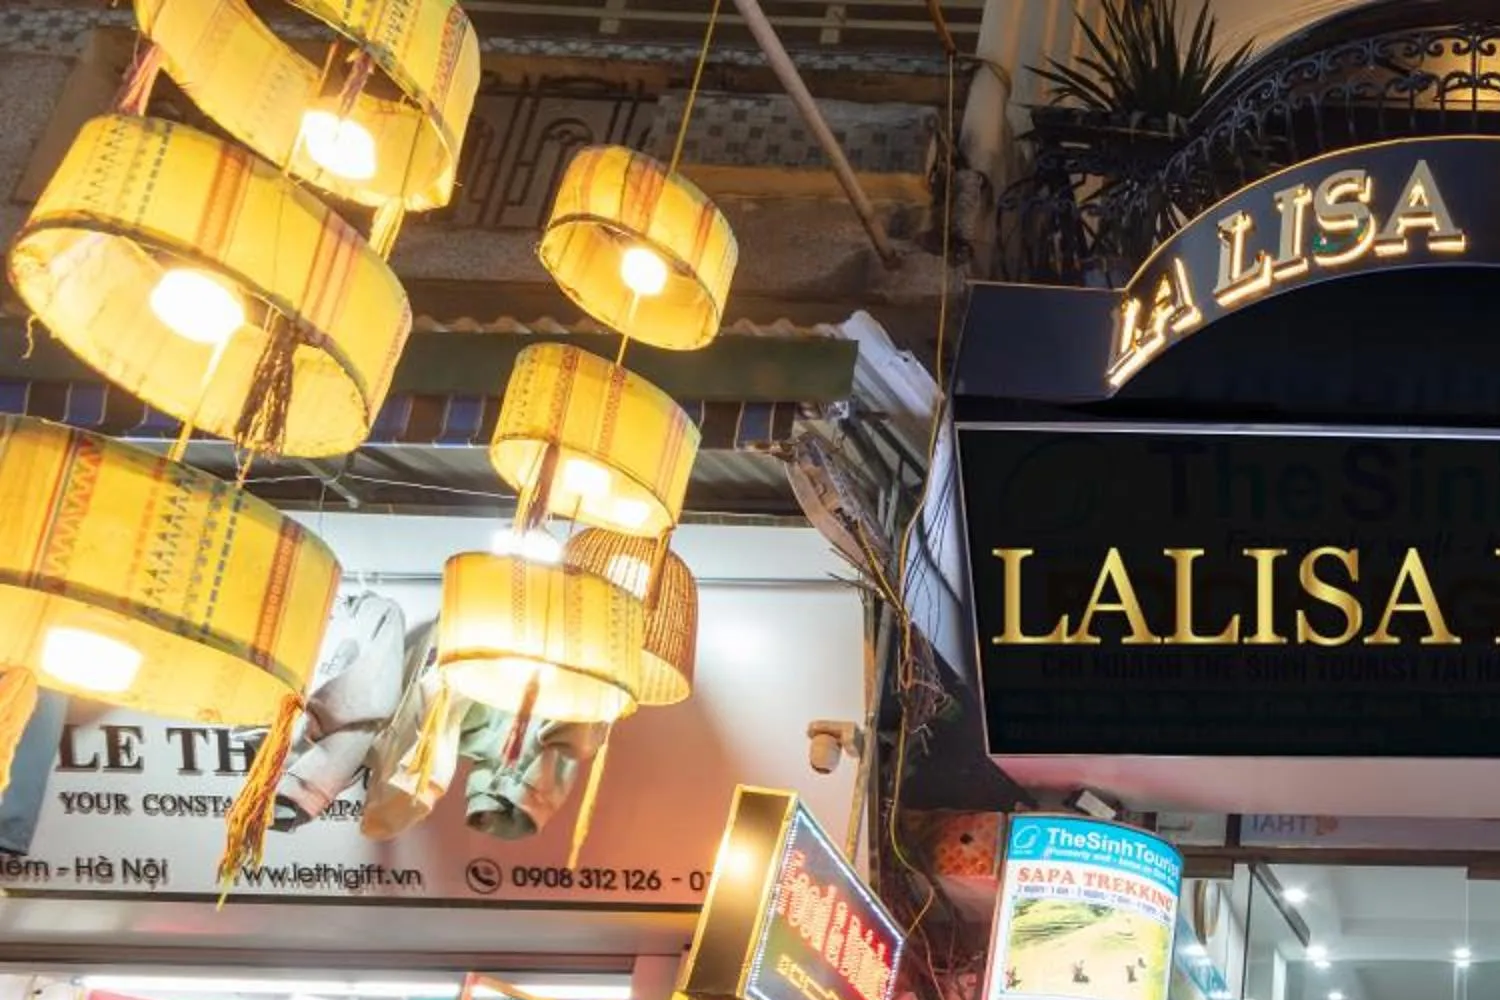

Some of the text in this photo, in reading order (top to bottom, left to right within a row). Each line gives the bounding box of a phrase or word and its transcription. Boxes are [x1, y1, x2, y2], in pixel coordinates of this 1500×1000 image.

[1108, 256, 1199, 389] LA
[1214, 158, 1466, 307] LISA
[991, 545, 1464, 647] LALISA
[57, 724, 258, 776] LE TH
[59, 791, 234, 817] YOUR CONSTA
[1046, 826, 1180, 882] TheSinhTouris
[74, 855, 114, 879] Hà
[121, 857, 169, 890] Nội
[236, 861, 422, 892] ww.lethigift.vn
[511, 865, 573, 889] 0908
[577, 867, 617, 890] 312
[622, 868, 662, 892] 126
[1017, 866, 1075, 886] SAPA
